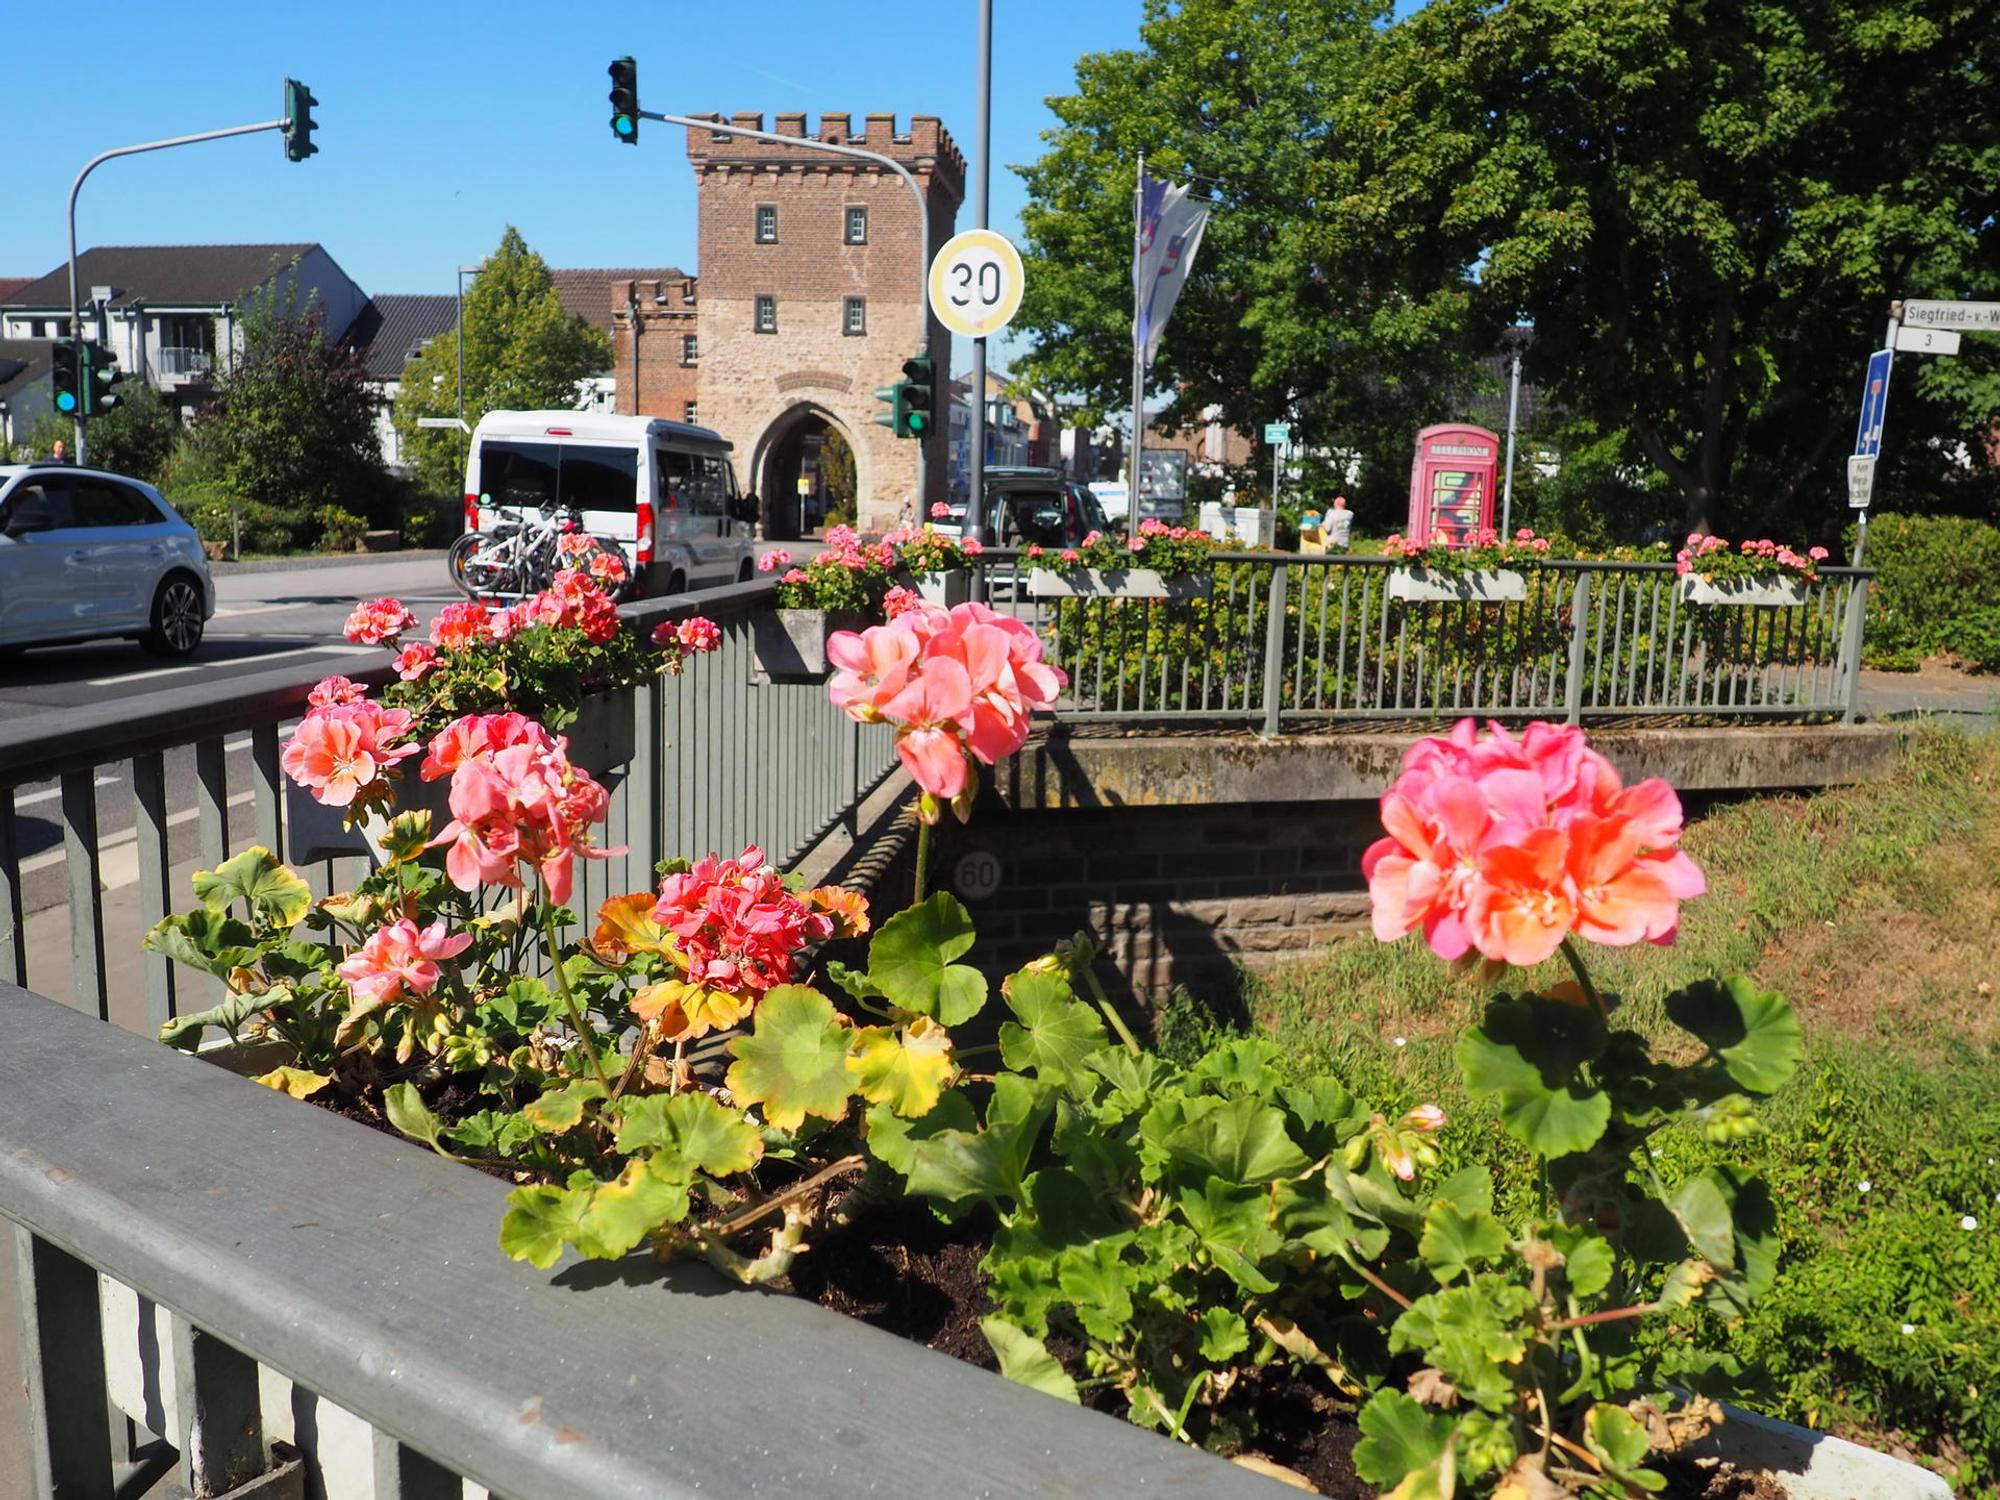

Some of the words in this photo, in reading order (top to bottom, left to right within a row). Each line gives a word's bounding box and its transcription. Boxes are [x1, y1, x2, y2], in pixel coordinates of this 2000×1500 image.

[951, 261, 1000, 306] 30
[1925, 333, 1933, 347] 3
[961, 860, 994, 888] 60
